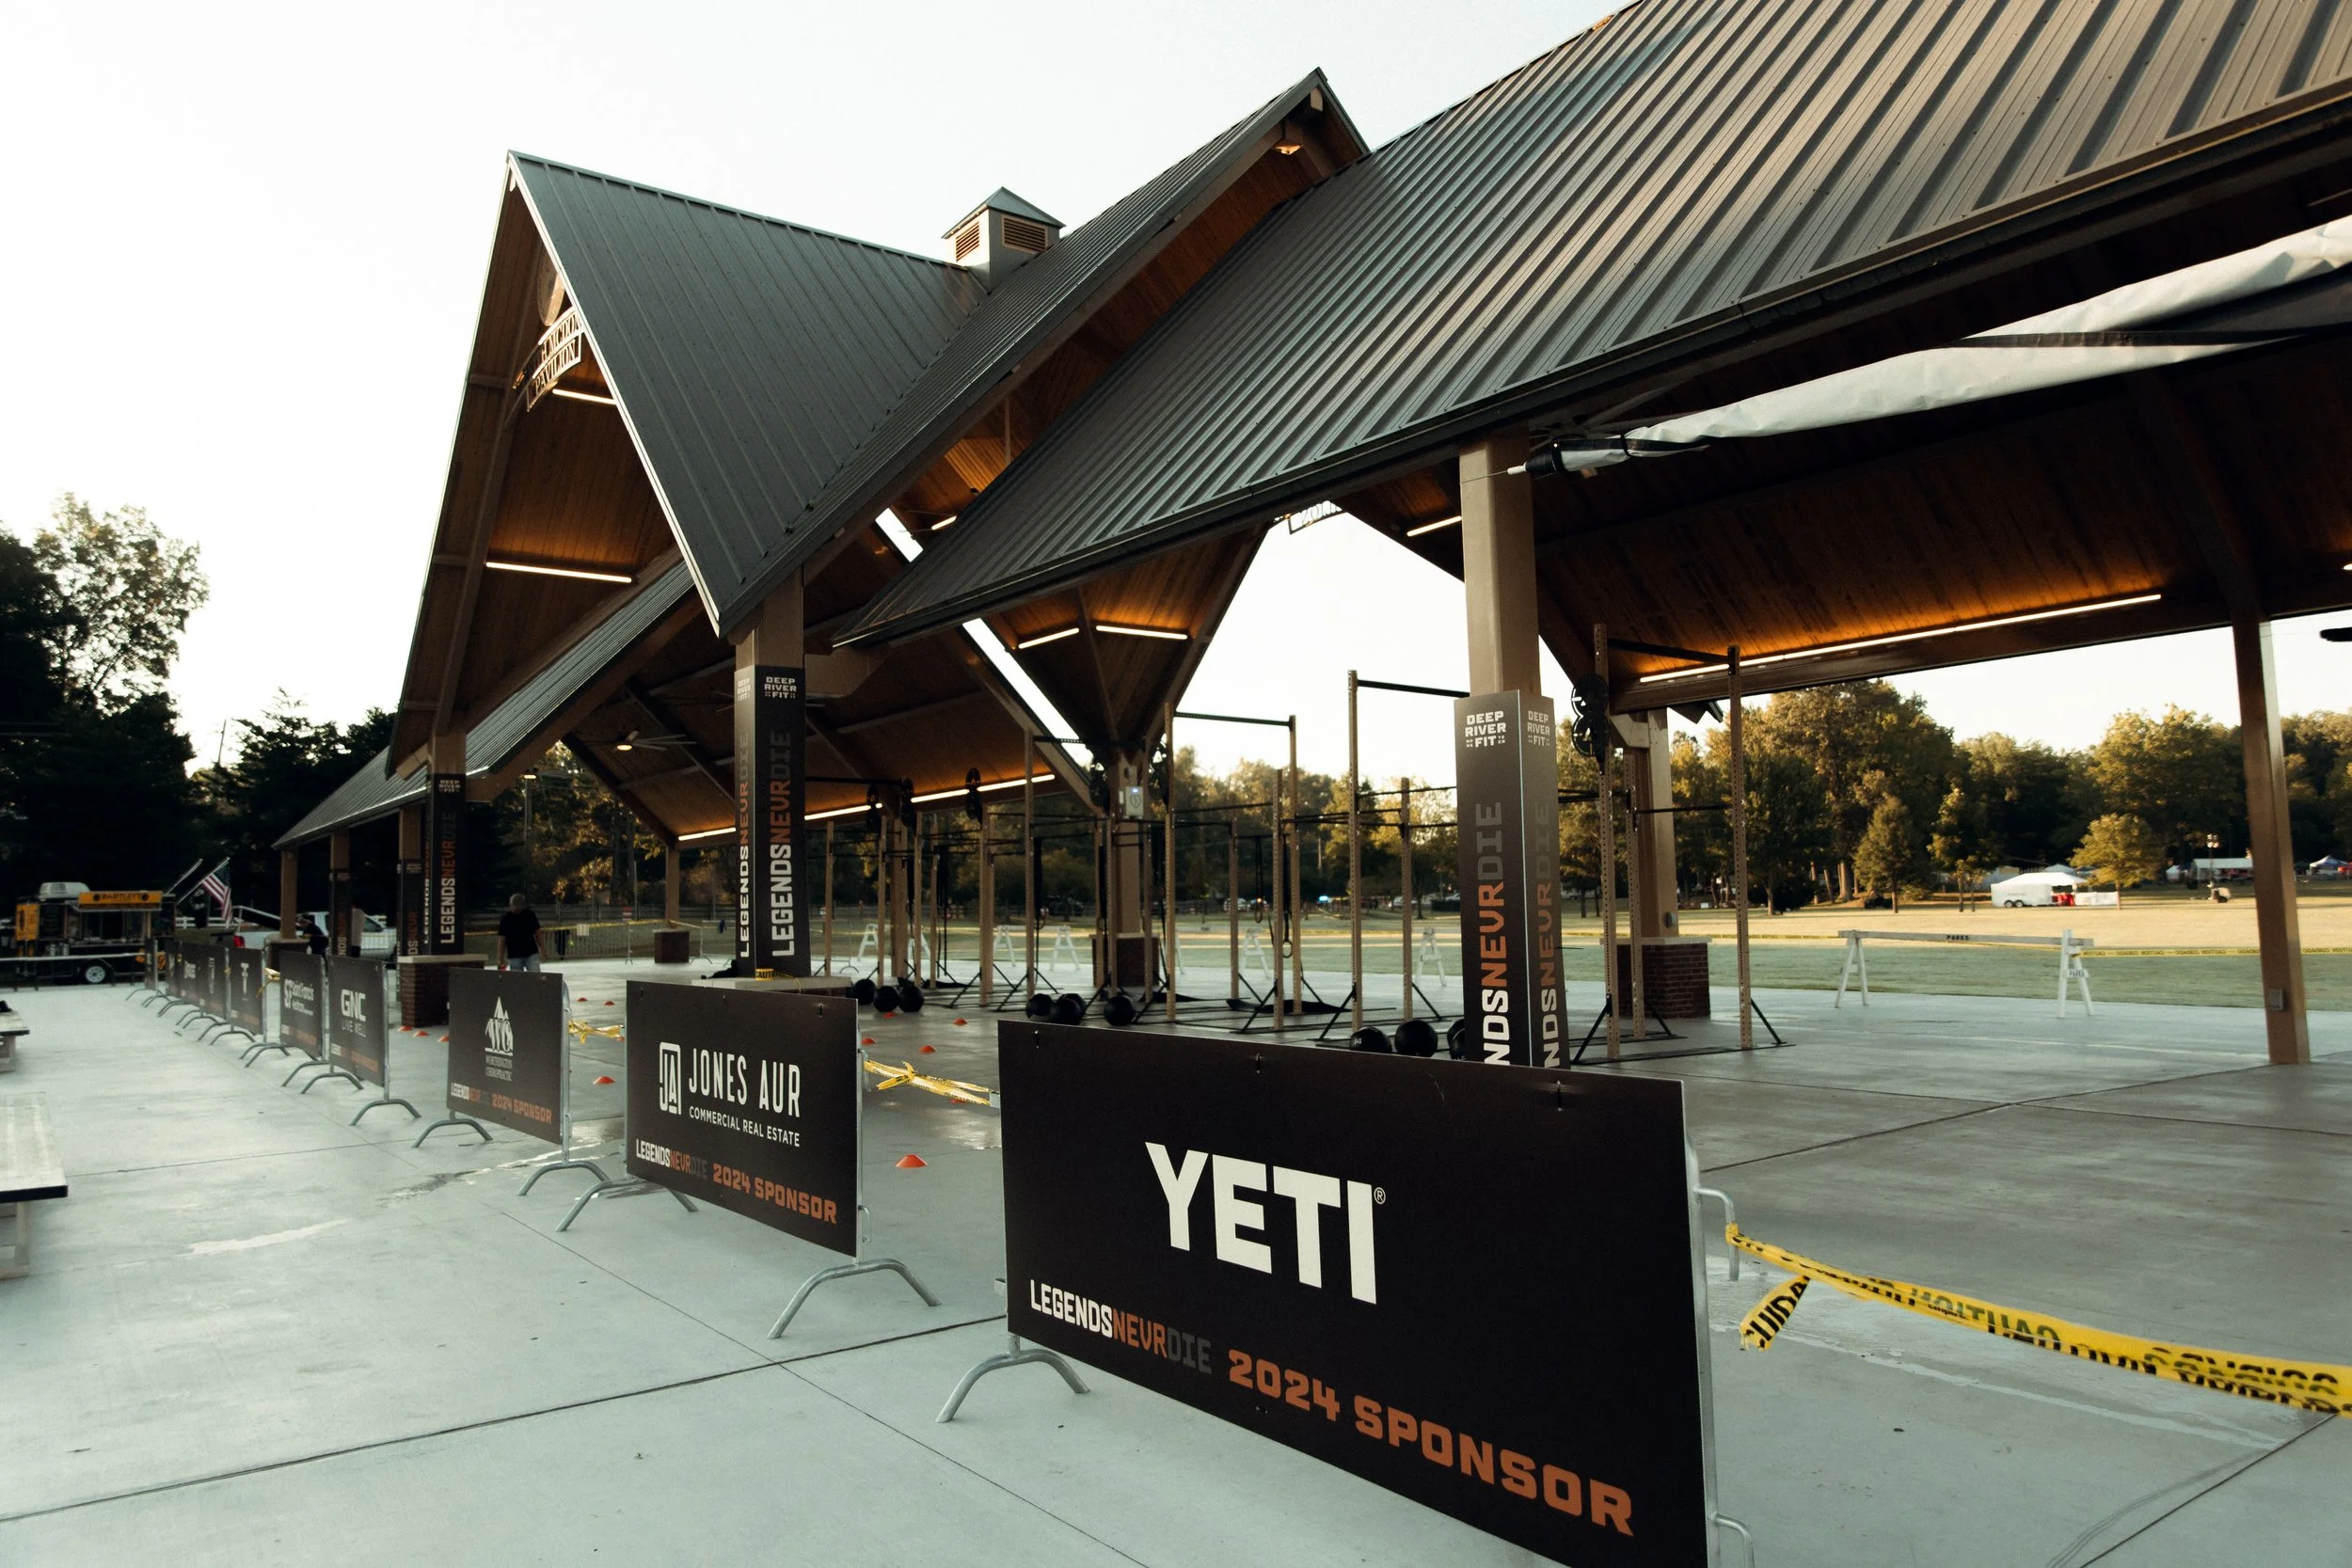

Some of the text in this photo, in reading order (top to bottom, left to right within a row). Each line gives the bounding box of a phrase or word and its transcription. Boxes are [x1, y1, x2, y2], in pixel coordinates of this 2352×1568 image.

[534, 340, 576, 396] PAVILION
[738, 677, 751, 688] DEEP
[764, 683, 797, 692] RIVER
[765, 676, 796, 685] DEEP
[738, 685, 751, 694] RIVER
[1466, 710, 1504, 725] DEEP
[1528, 710, 1549, 723] DEEP
[1465, 722, 1506, 737] RIVER
[1527, 721, 1550, 736] RIVER
[1474, 735, 1497, 748] FIT
[1534, 735, 1546, 747] FIT
[341, 989, 367, 1022] GNC
[689, 1047, 748, 1105] JONES
[758, 1059, 801, 1117] AUR
[491, 1092, 513, 1112] 2024
[513, 1099, 553, 1124] SPONSOR
[689, 1105, 801, 1148] COMMERCIAL REAL ESTATE
[712, 1163, 751, 1196] 2024
[754, 1177, 837, 1225] SPONSOR
[1229, 1349, 1341, 1422] 2024
[1354, 1395, 1634, 1538] SPONSOR
